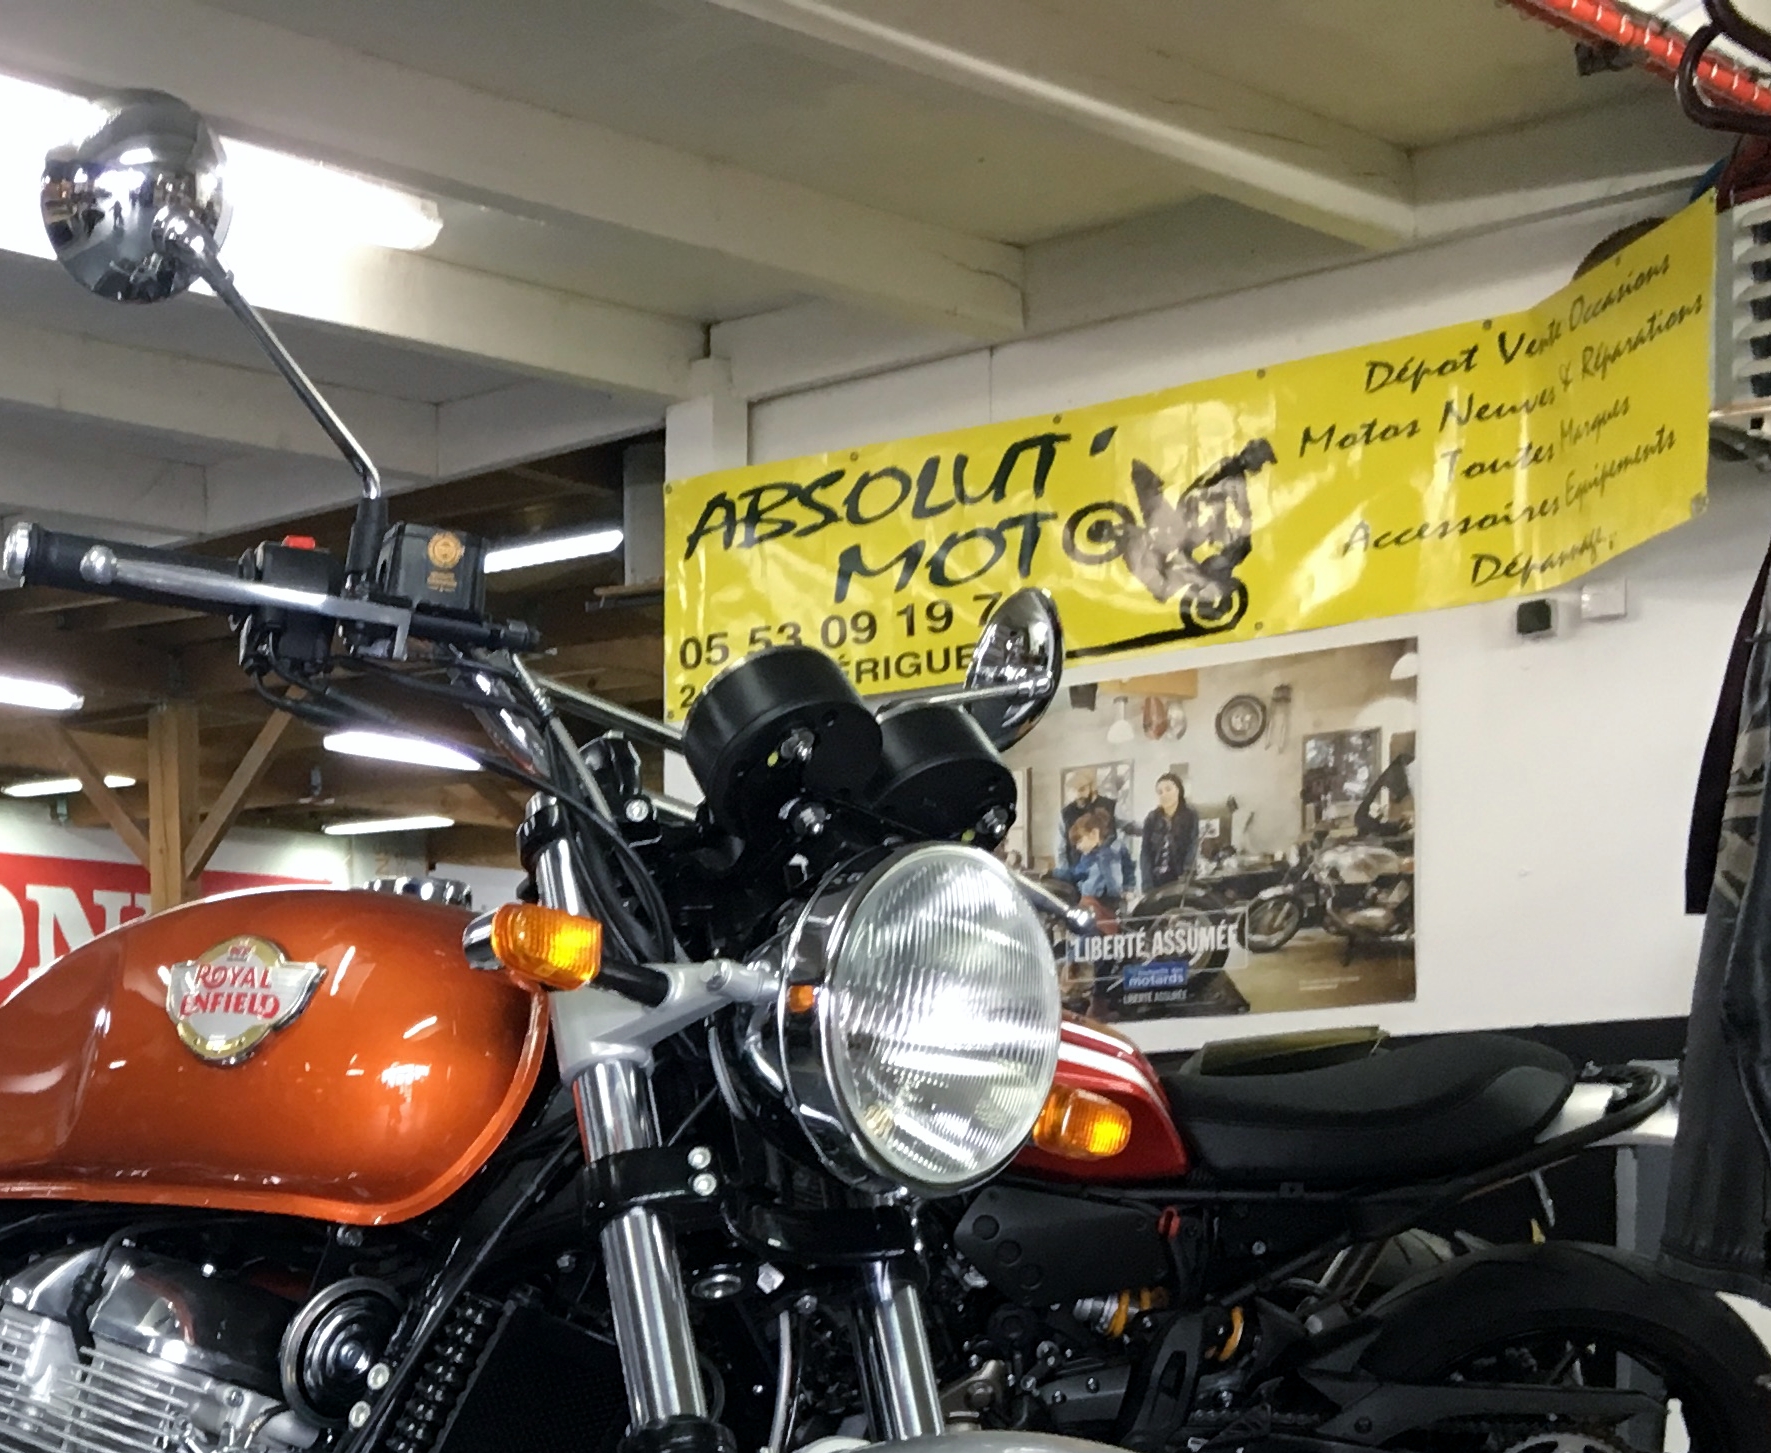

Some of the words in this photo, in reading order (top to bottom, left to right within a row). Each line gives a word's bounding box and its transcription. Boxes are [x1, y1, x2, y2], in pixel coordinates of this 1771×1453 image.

[1498, 319, 1562, 365] Vente
[1569, 253, 1670, 332] Occasions
[1299, 417, 1421, 459] Motos
[1438, 386, 1556, 433] Neuves
[1440, 441, 1554, 484] Toutes
[1559, 396, 1630, 452] Marques
[1341, 496, 1560, 557] Accessoires
[679, 632, 730, 671] 05
[820, 609, 878, 649] 09
[896, 600, 954, 637] 19
[972, 591, 1003, 628] 7
[1073, 926, 1147, 963] LIBERTÉ
[1151, 919, 1239, 955] ASSUMÉE
[179, 991, 281, 1019] ENFIELD
[194, 963, 273, 990] ROYAL
